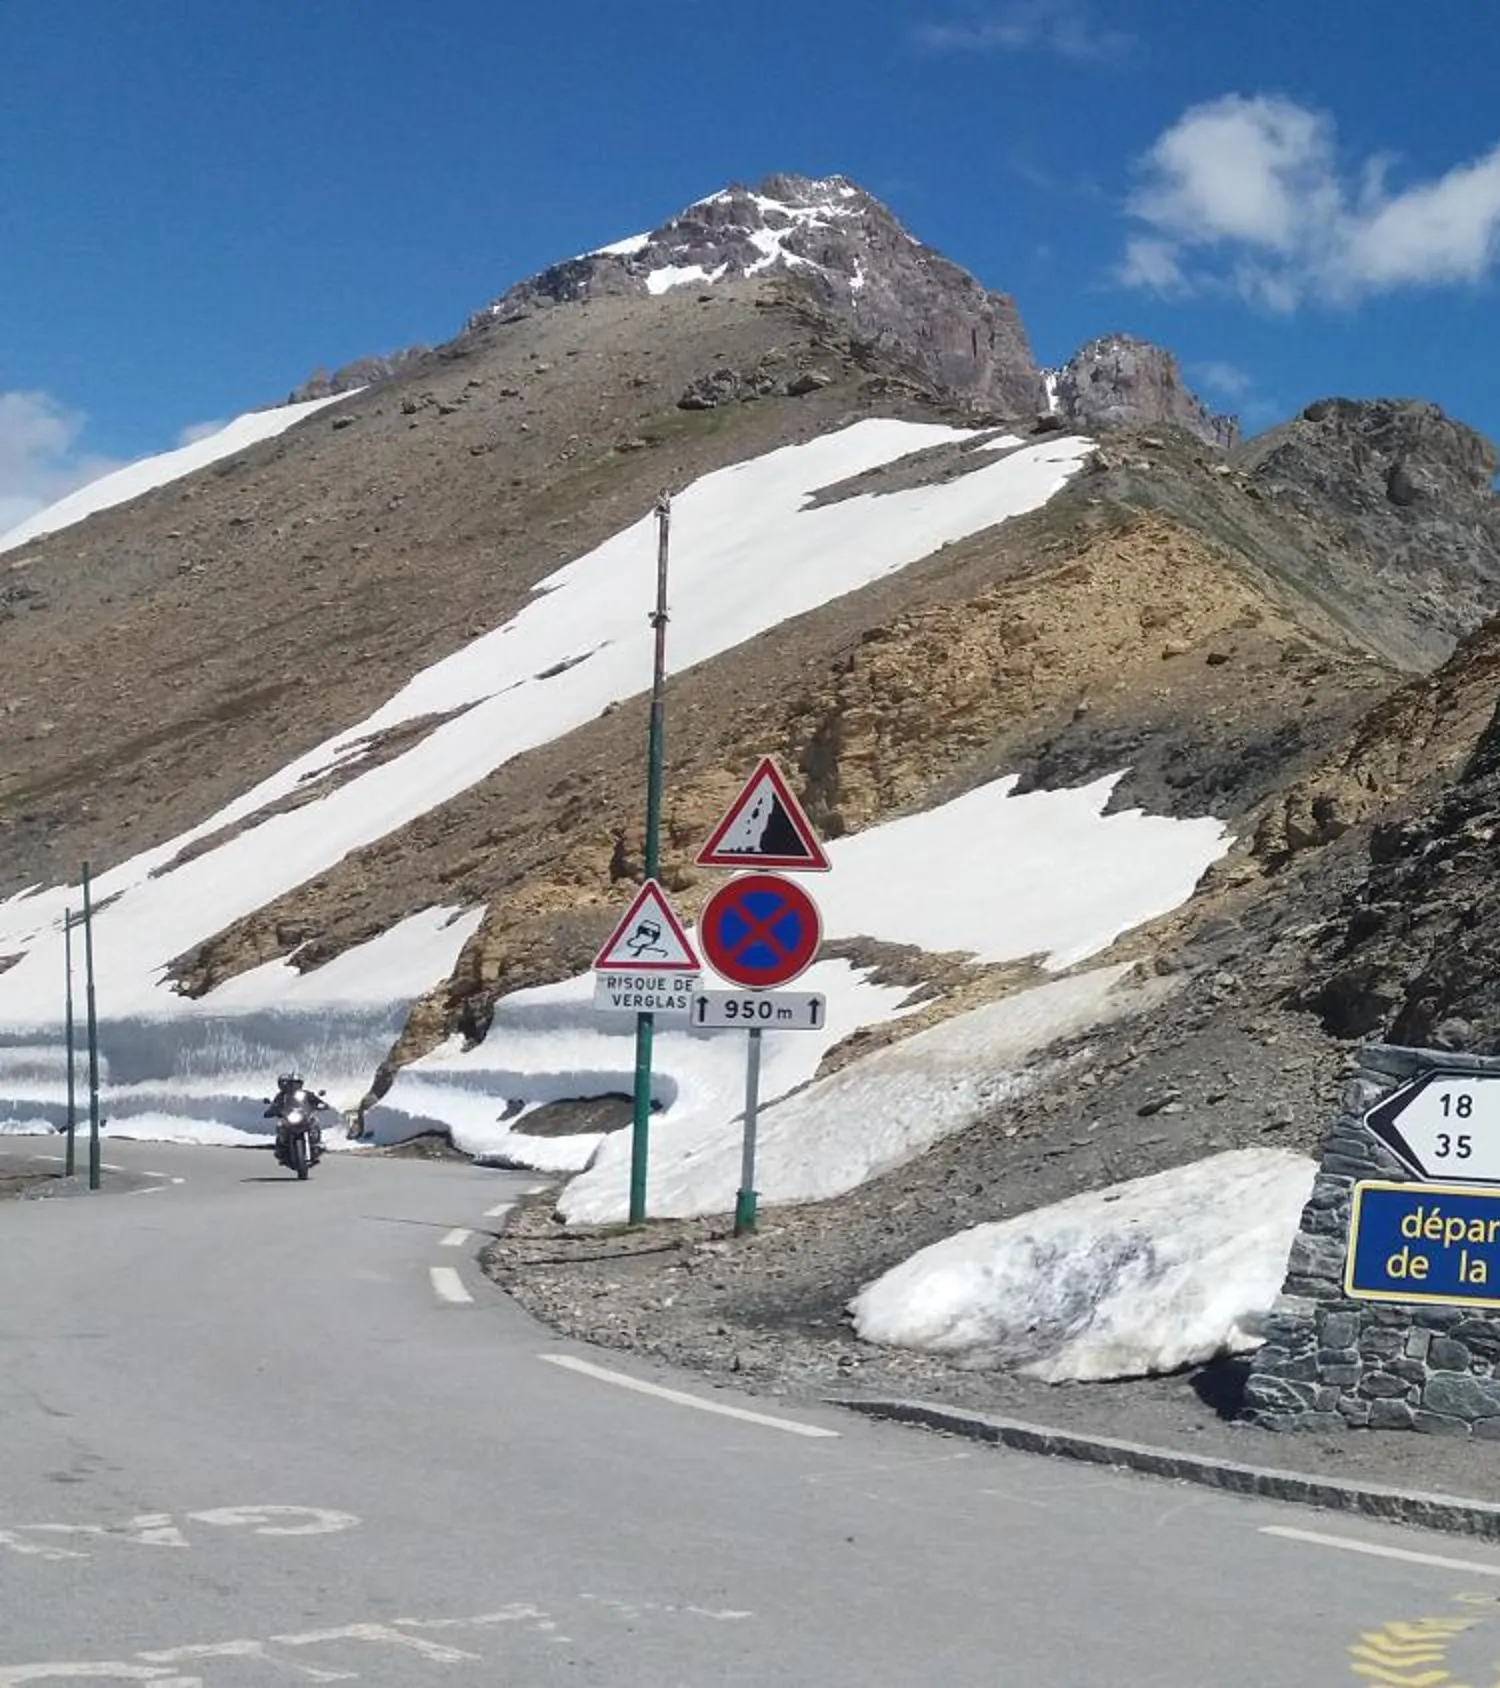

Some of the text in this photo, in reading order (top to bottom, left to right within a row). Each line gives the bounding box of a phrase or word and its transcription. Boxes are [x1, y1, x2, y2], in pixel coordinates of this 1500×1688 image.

[607, 977, 693, 992] RISQUE DE
[613, 994, 687, 1009] VERGLAS
[724, 1000, 793, 1020] 950 m
[1439, 1094, 1473, 1119] 18
[1435, 1134, 1473, 1159] 35
[1386, 1245, 1428, 1280] de
[1459, 1250, 1487, 1284] la
